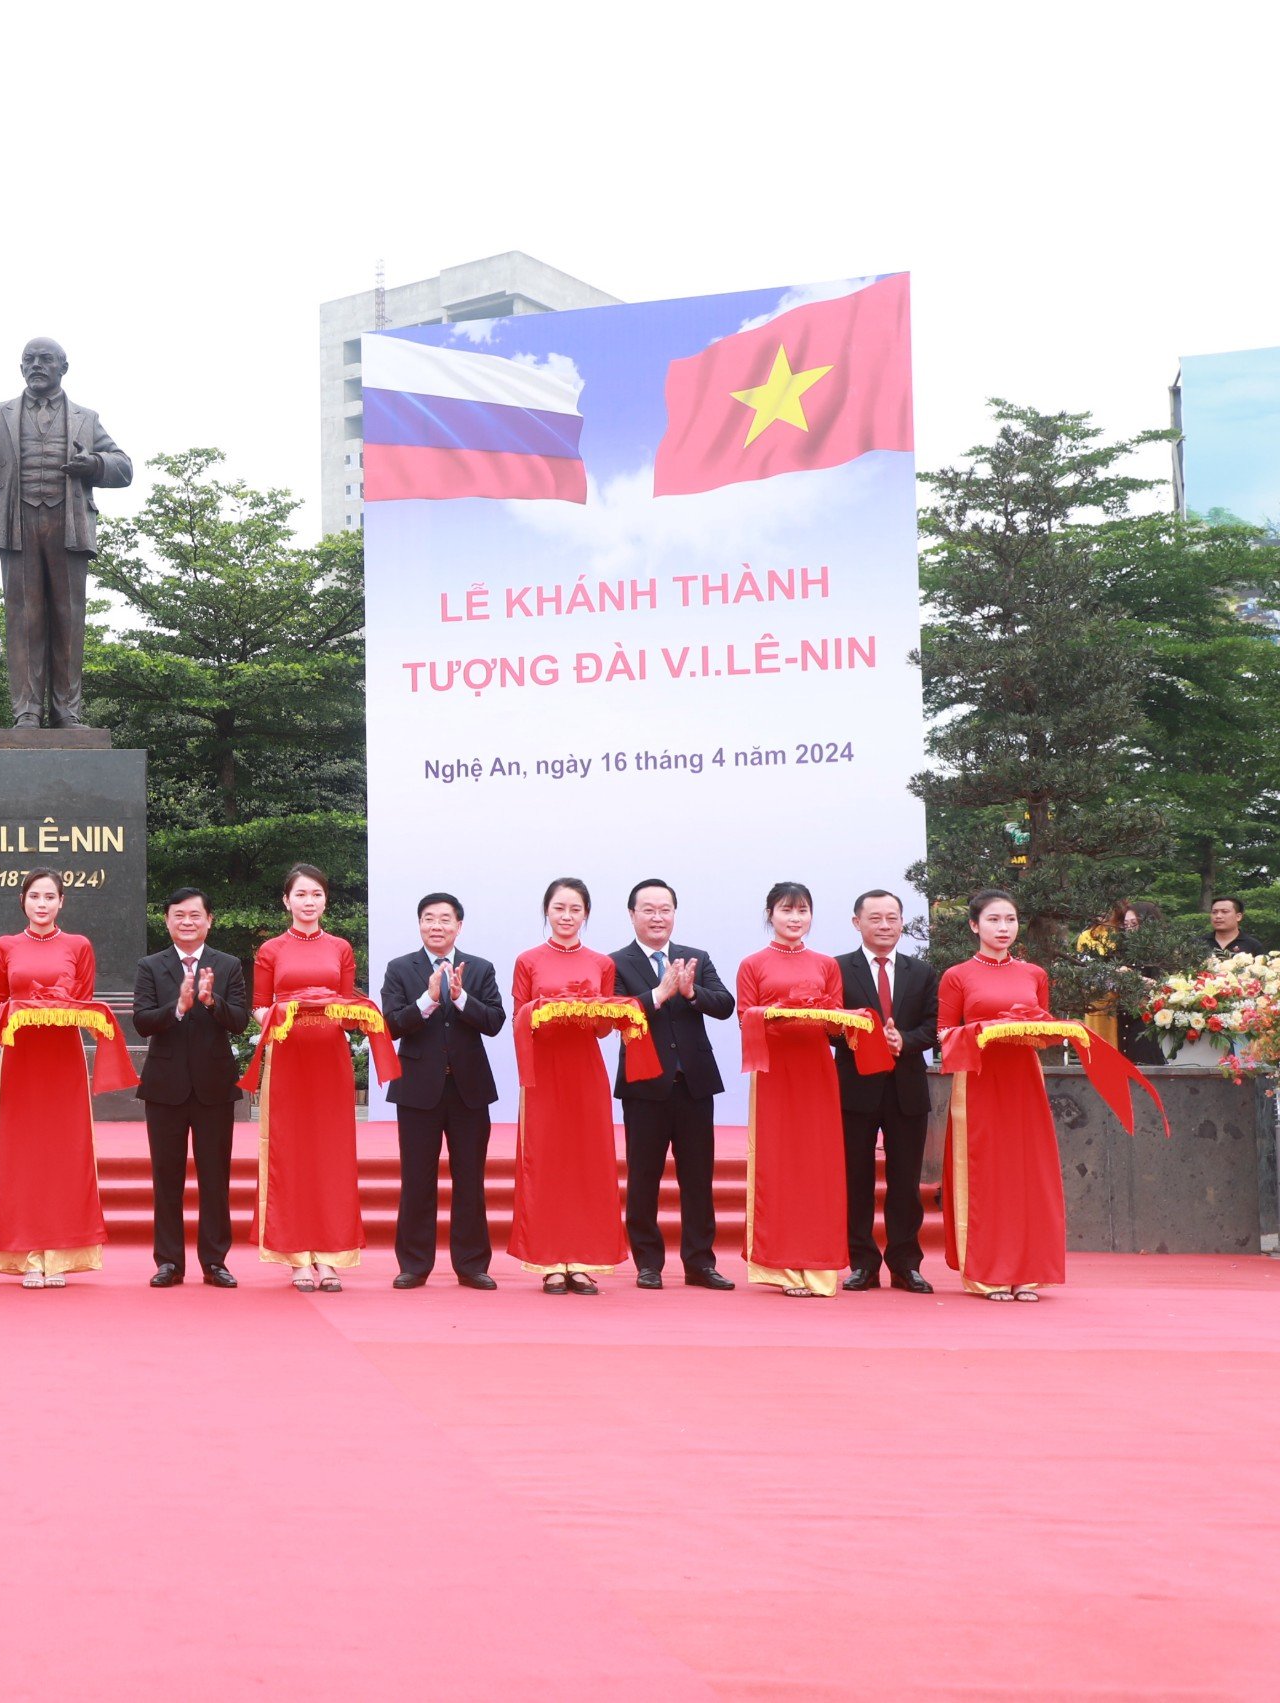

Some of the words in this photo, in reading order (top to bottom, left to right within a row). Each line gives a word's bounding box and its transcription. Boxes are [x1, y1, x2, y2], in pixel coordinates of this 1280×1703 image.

[440, 581, 490, 623] LỄ
[506, 574, 657, 618] KHÁNH
[672, 563, 830, 607] THÀNH
[402, 654, 560, 698] TƯỢNG
[572, 641, 647, 684] ĐÀI
[660, 632, 877, 679] V.I.LÊ-NIN
[424, 757, 483, 784] Nghệ
[488, 756, 528, 778] An,
[535, 753, 593, 780] ngày
[600, 750, 628, 773] 16
[634, 747, 704, 774] tháng
[711, 747, 726, 768] 4
[734, 745, 787, 767] năm
[795, 741, 855, 765] 2024
